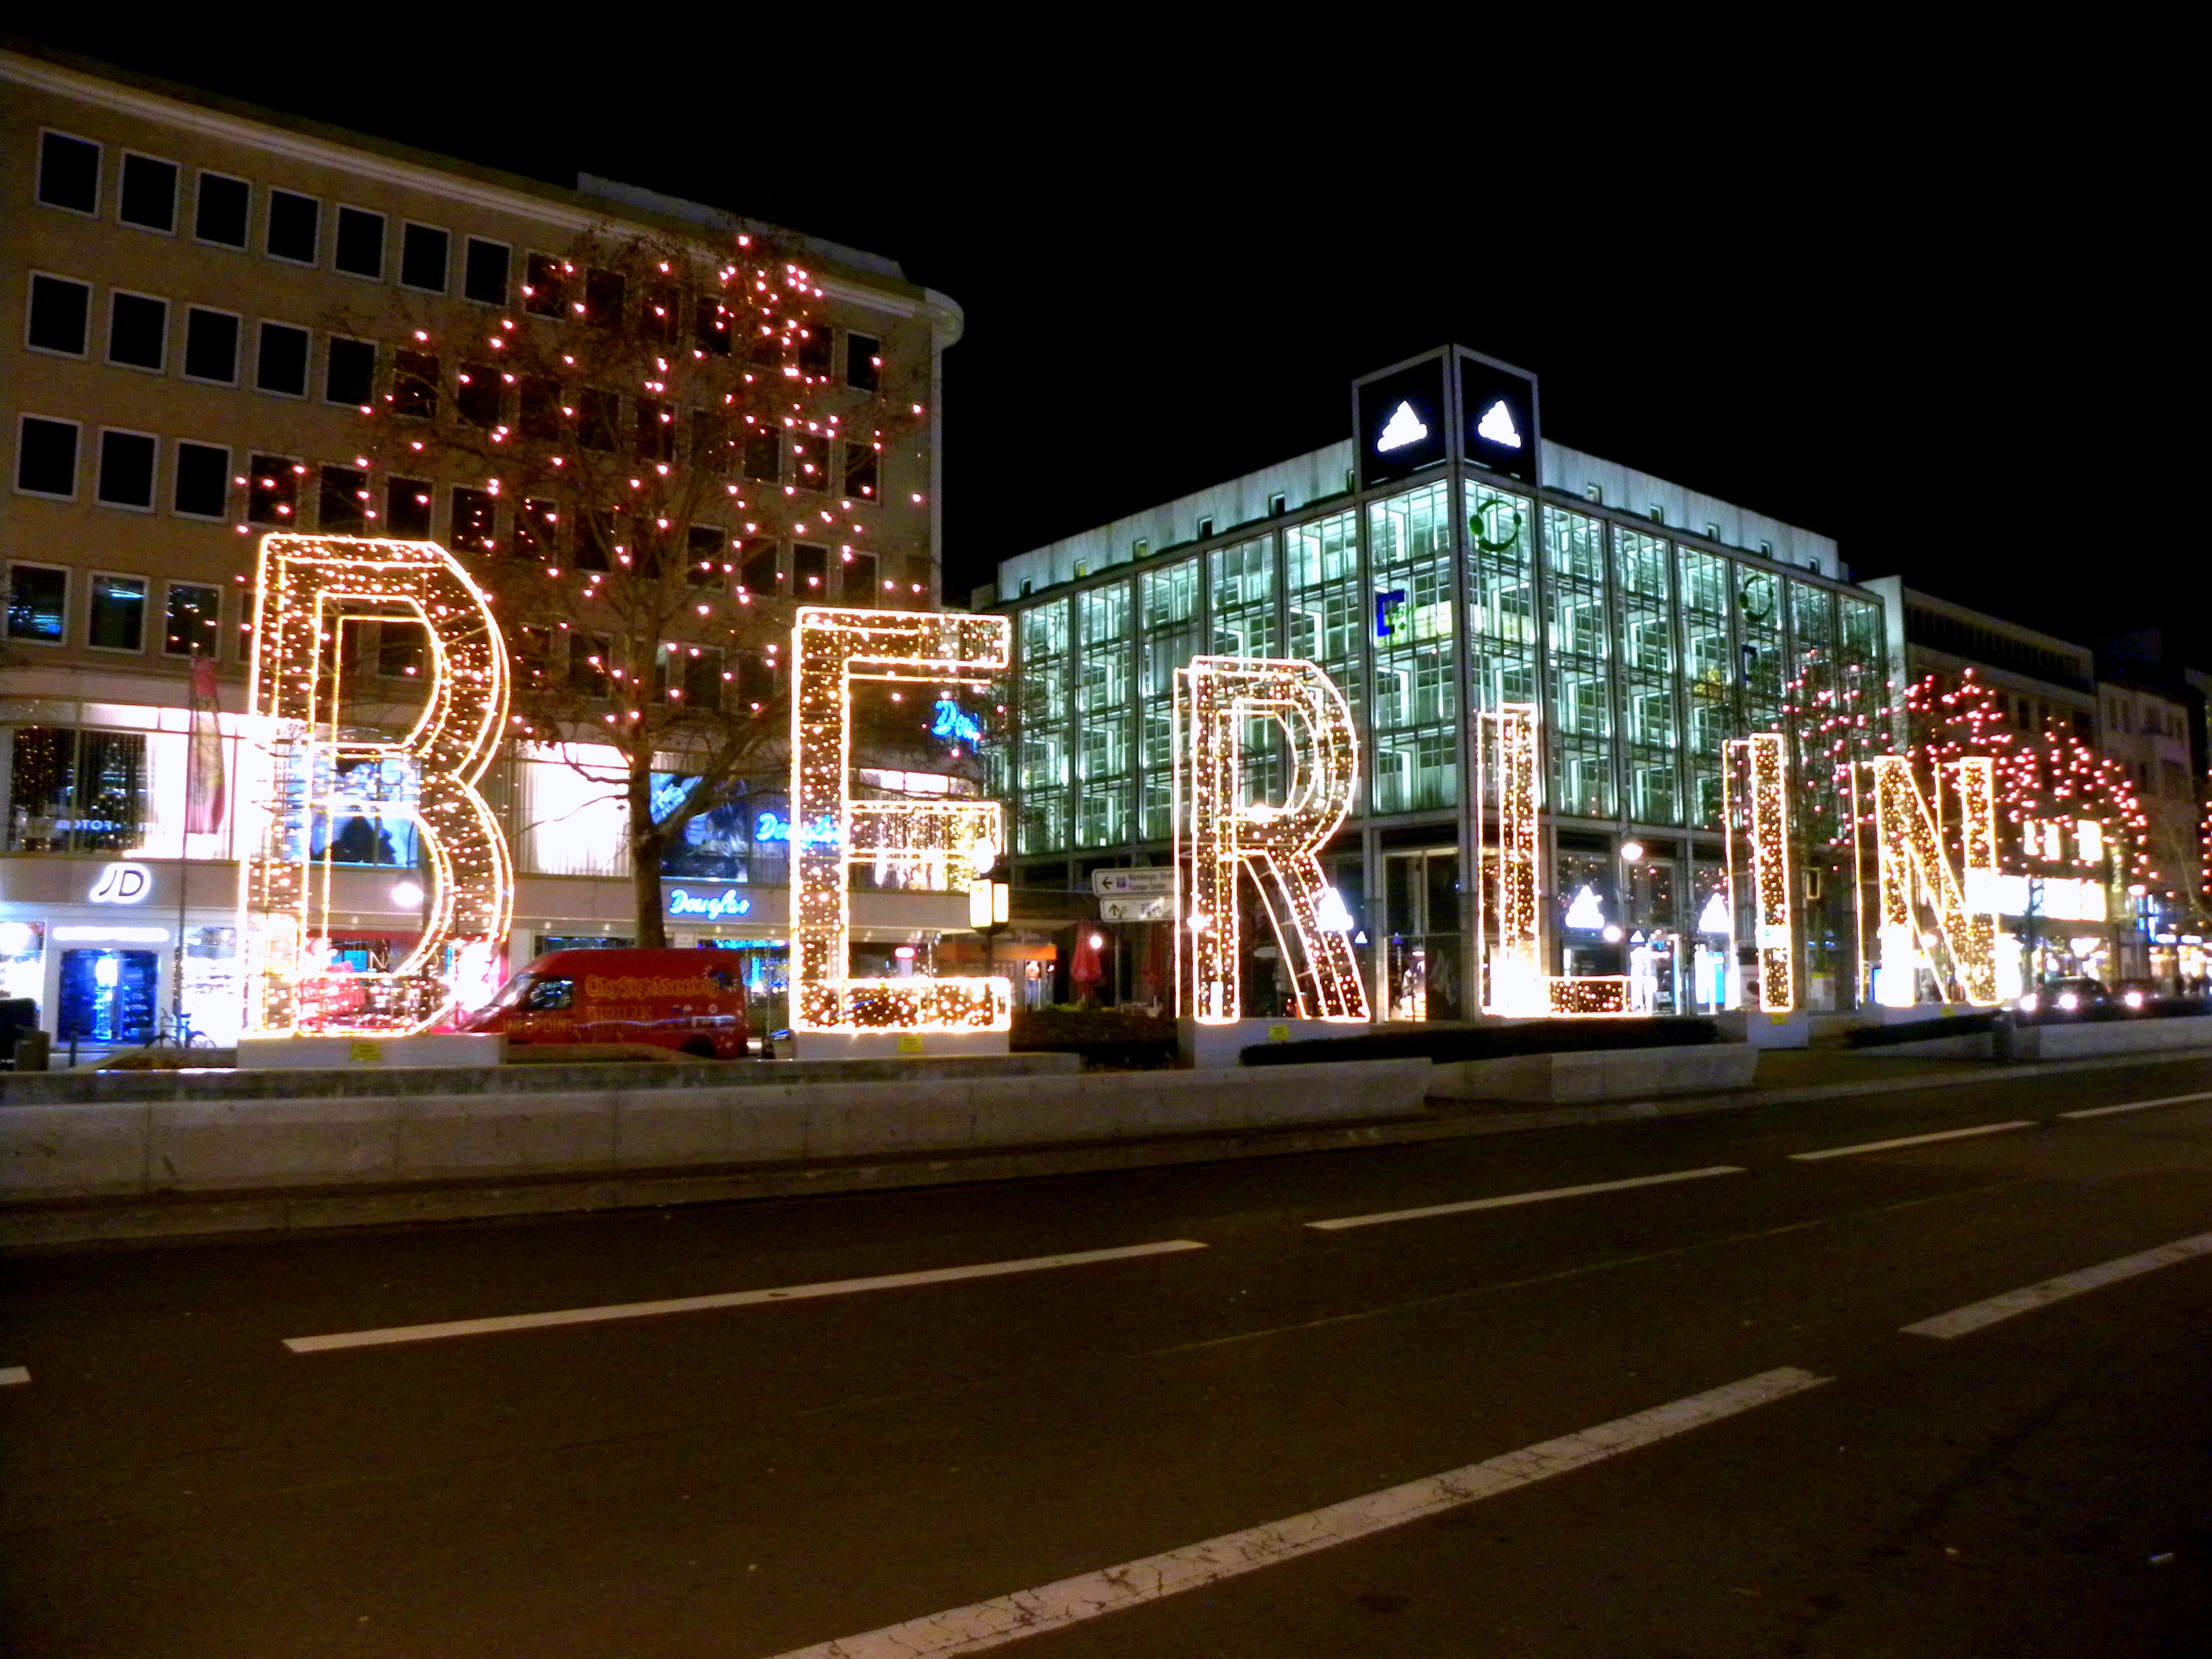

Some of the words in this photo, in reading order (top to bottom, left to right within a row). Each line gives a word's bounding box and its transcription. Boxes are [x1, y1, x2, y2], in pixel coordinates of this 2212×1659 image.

[237, 531, 2004, 1041] BERLIN
[95, 866, 147, 900] JD
[669, 888, 751, 921] Douglas
